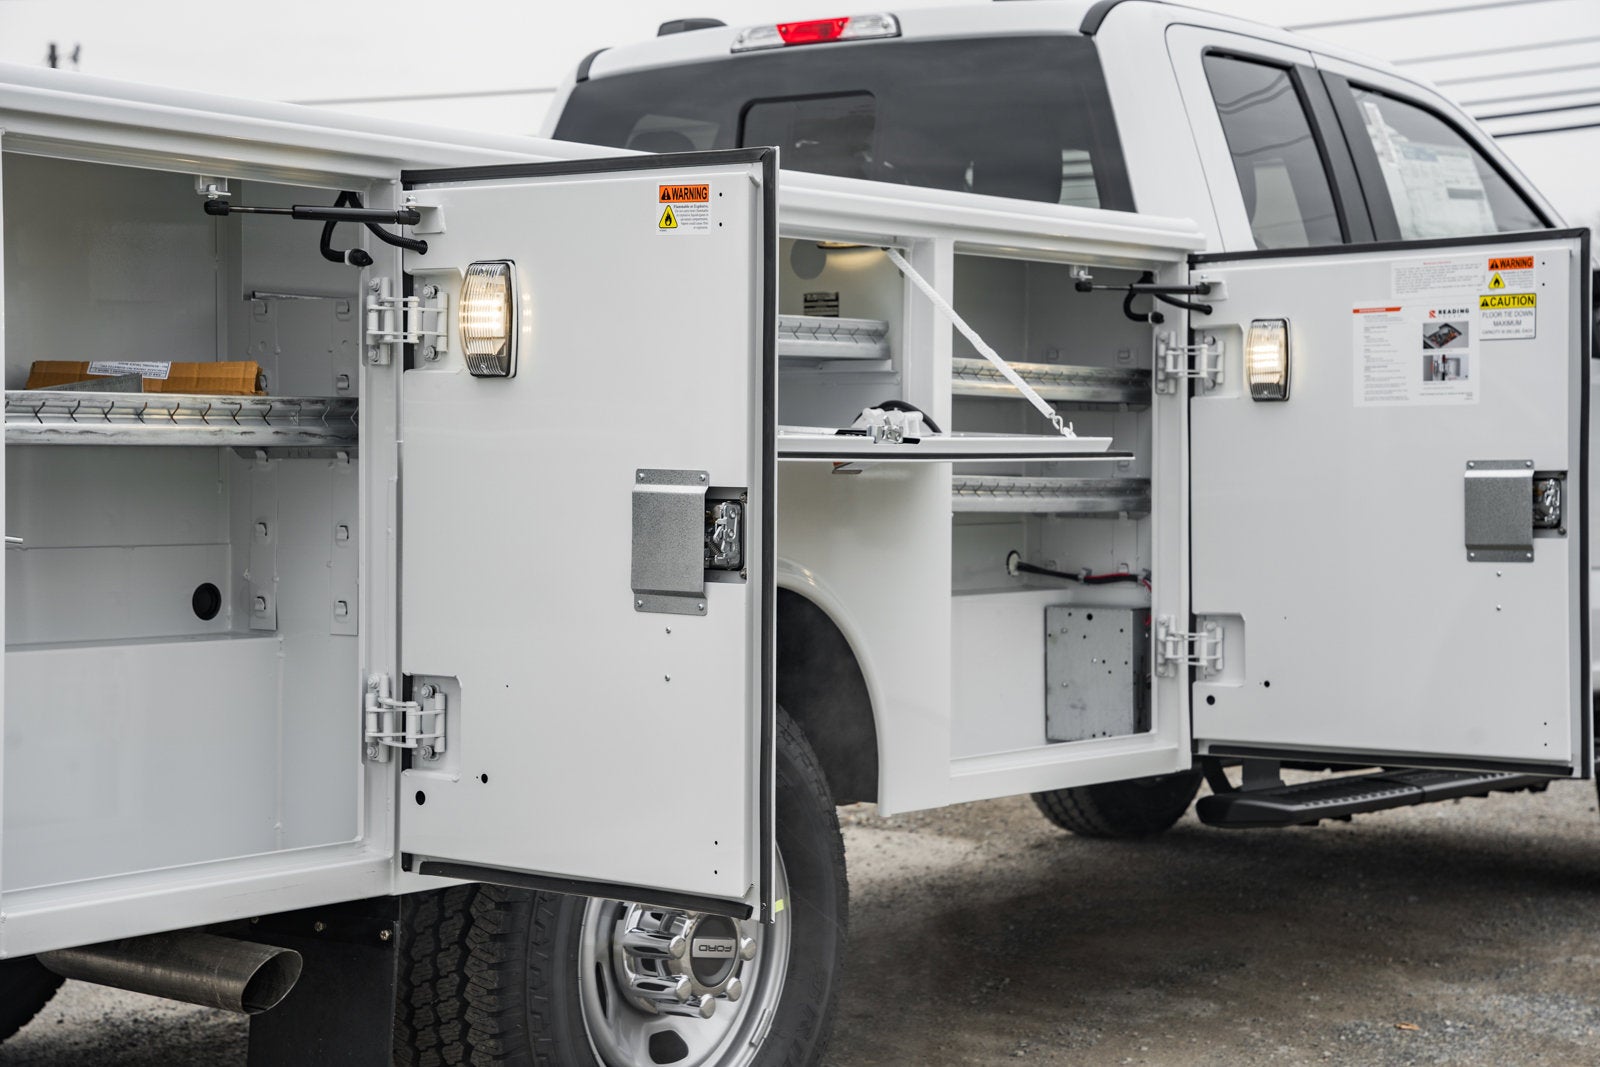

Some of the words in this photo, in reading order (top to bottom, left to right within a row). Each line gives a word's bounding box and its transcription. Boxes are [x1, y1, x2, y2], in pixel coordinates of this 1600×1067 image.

[672, 187, 707, 200] WARNING
[1500, 257, 1532, 268] WARNING
[1490, 296, 1534, 307] CAUTION
[1482, 311, 1502, 319] FLOOR
[699, 944, 732, 952] FORD
